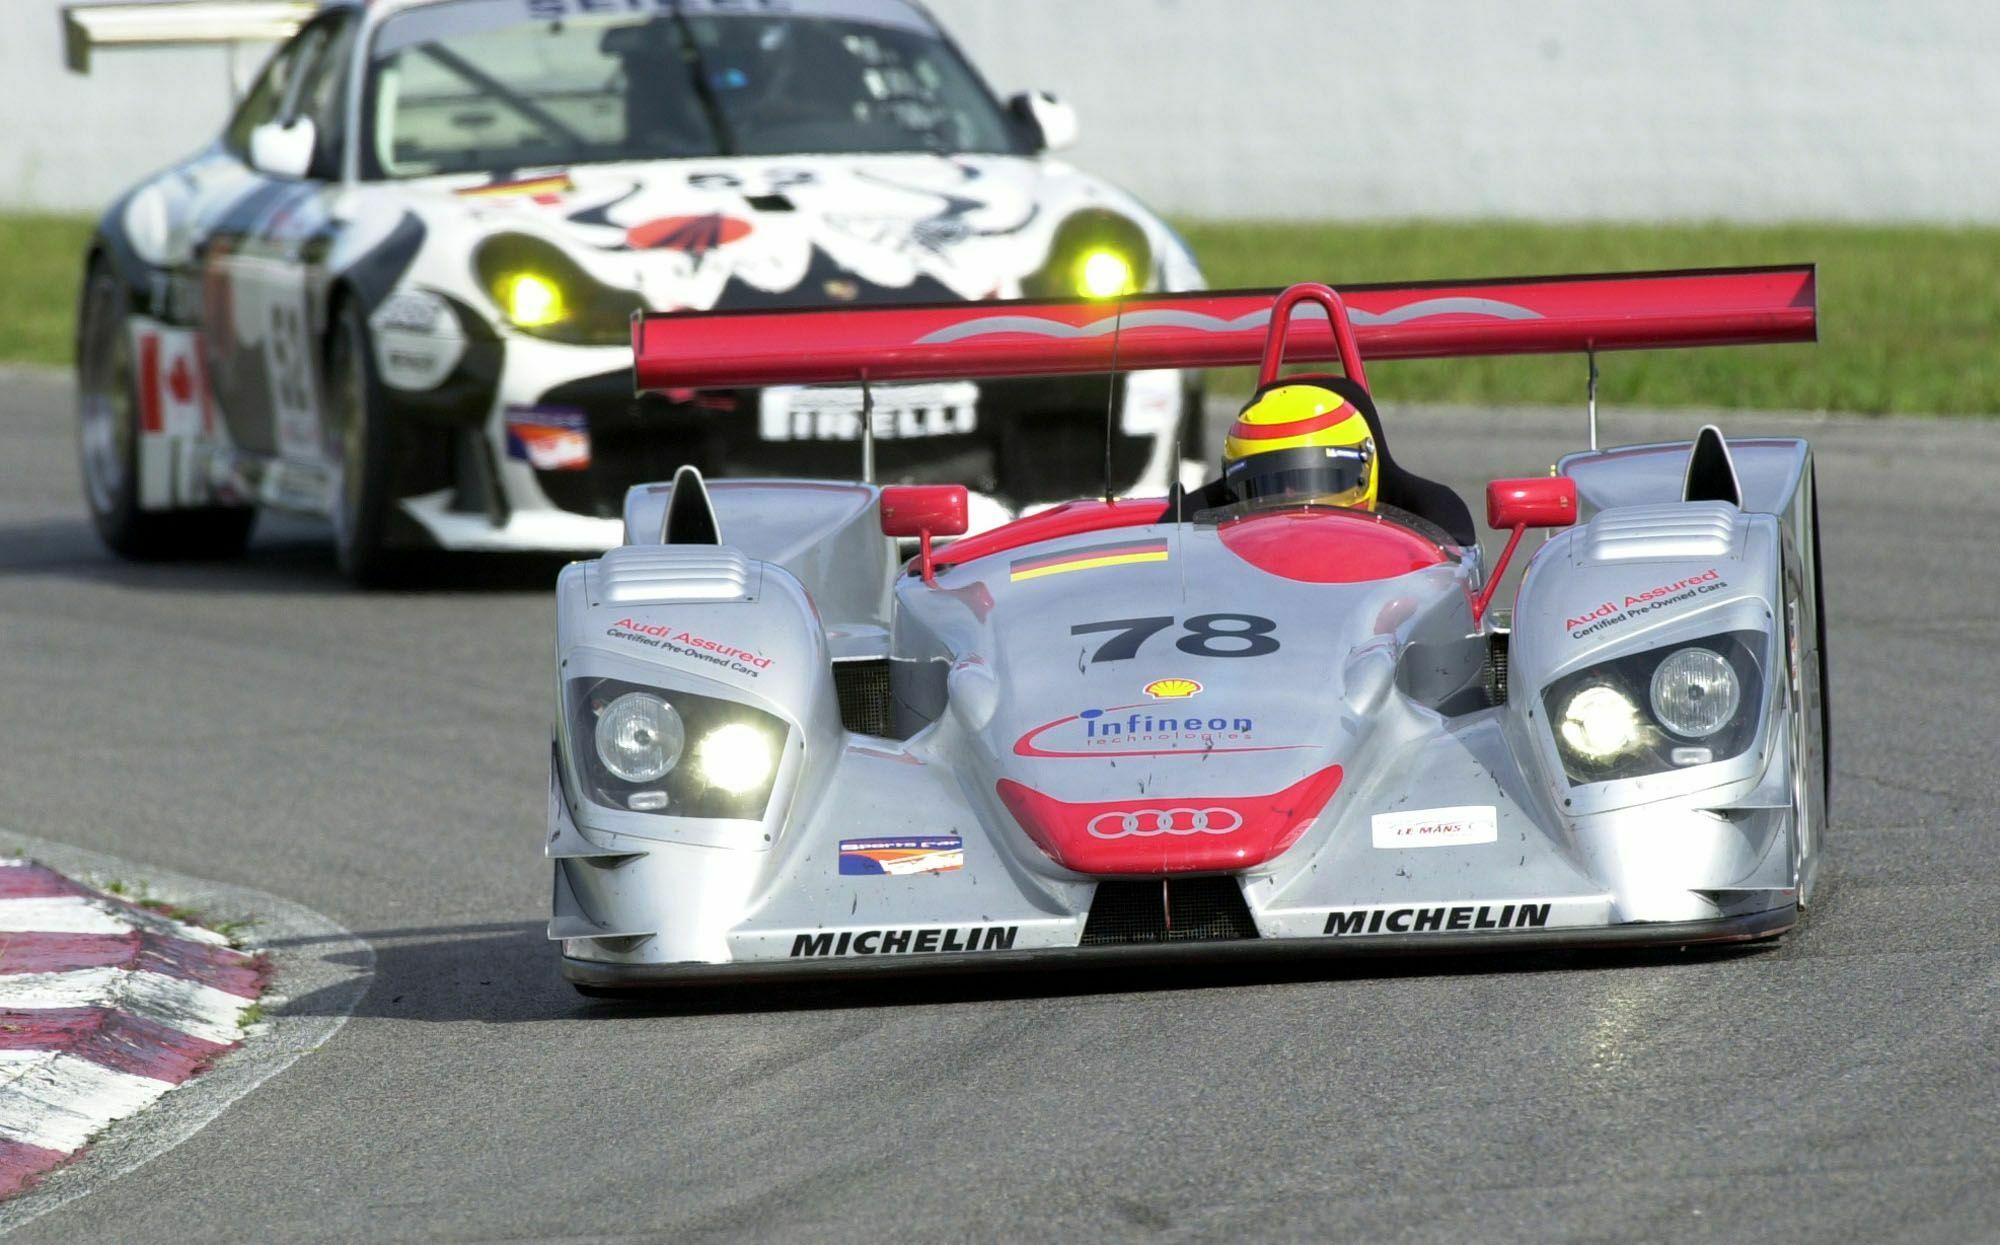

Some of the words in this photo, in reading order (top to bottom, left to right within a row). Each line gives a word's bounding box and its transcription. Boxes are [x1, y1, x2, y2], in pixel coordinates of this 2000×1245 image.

[760, 381, 979, 441] PIRELLI
[1566, 602, 1618, 632] Audi
[1624, 569, 1720, 607] Assured
[1572, 613, 1628, 640] Certified
[1628, 589, 1697, 618] Pre-Owned
[1698, 581, 1728, 594] Cars
[606, 628, 659, 647] Certified
[661, 641, 730, 667] Pre-Owned
[731, 662, 759, 678] Cars
[614, 618, 672, 637] Audi
[671, 632, 772, 668] Assured
[1071, 613, 1281, 663] 78
[790, 926, 1018, 957] MICHELIN
[1322, 904, 1551, 935] MICHELIN
